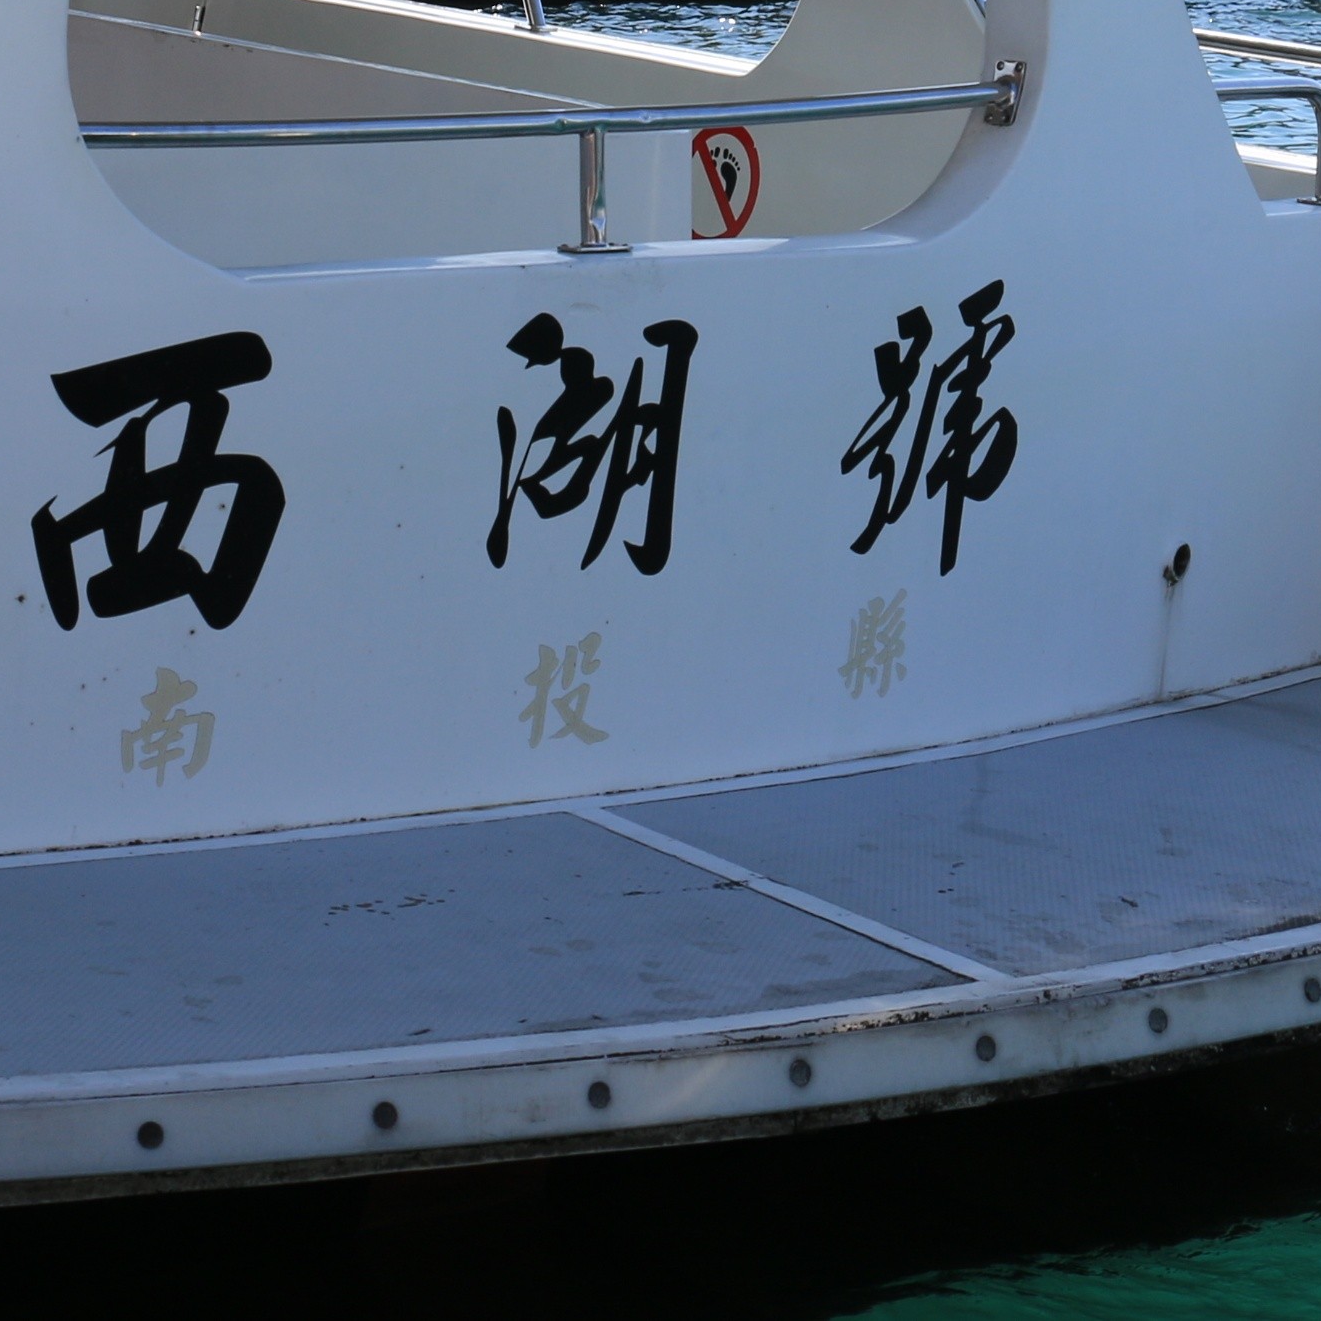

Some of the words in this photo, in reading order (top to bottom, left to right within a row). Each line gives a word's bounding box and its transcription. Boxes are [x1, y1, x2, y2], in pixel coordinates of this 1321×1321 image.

[31, 279, 1018, 632] 西湖號
[120, 589, 909, 787] 南投縣
